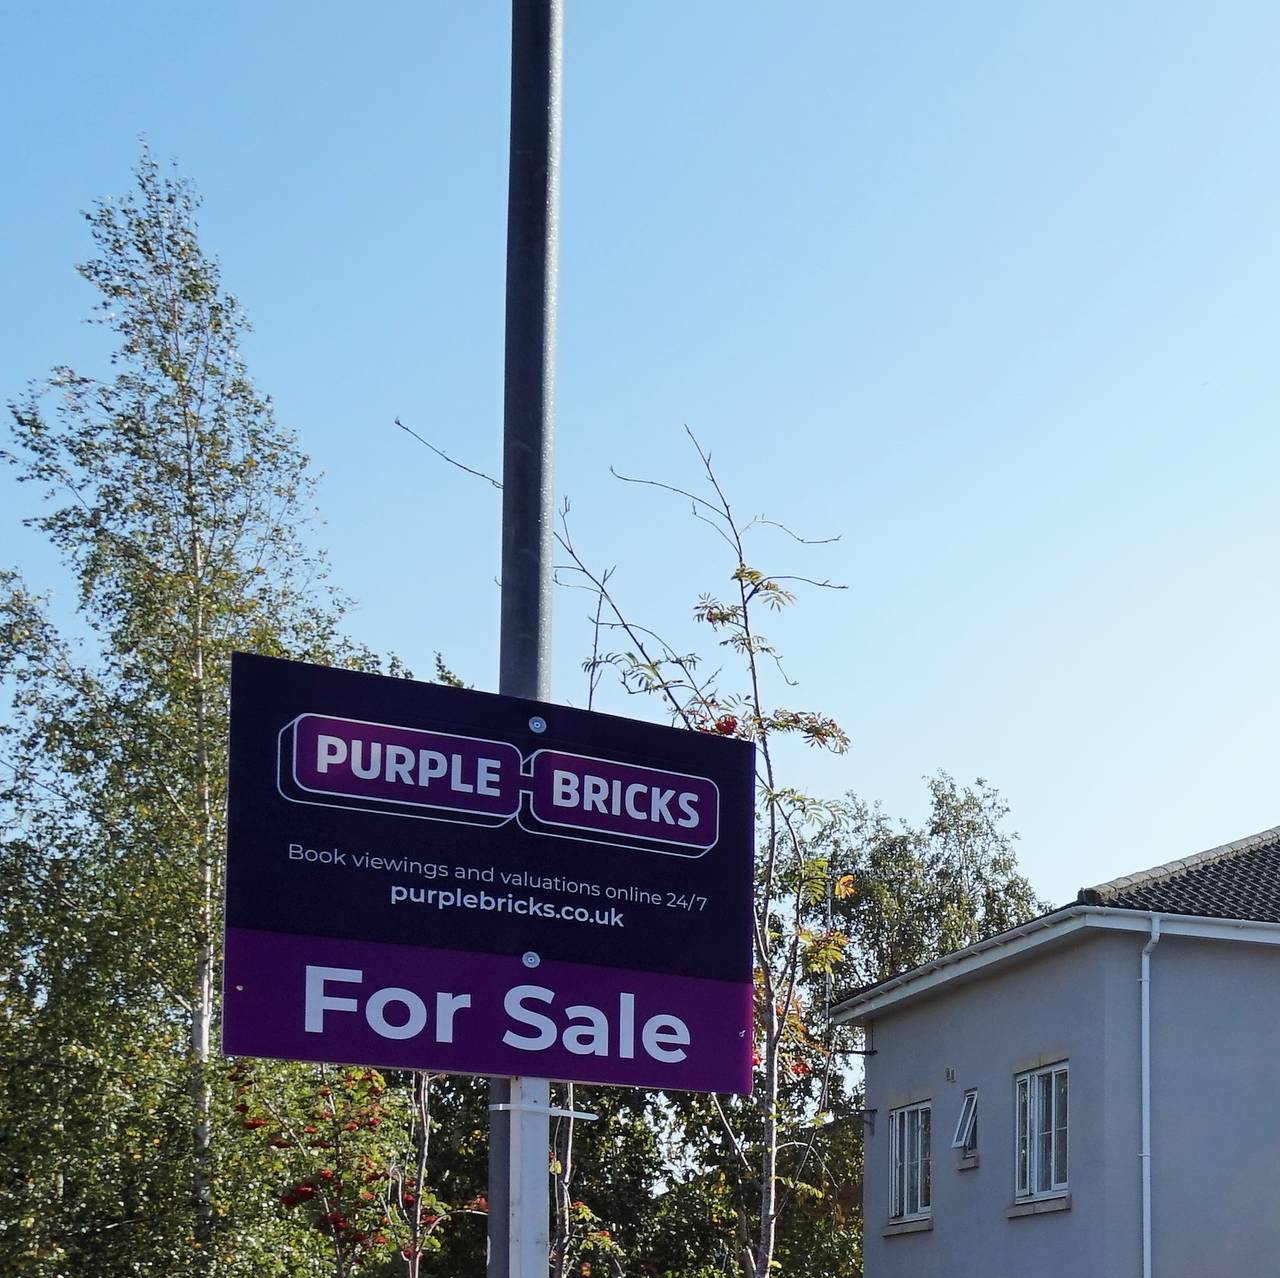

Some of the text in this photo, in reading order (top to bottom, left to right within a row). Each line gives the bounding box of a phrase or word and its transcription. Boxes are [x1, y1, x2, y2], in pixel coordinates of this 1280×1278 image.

[316, 734, 701, 829] PURPLE BRICKS
[288, 843, 708, 912] Book viewings and valuations online 24/7
[391, 885, 625, 928] purplebricks.co.uk
[304, 965, 691, 1064] For Sale
